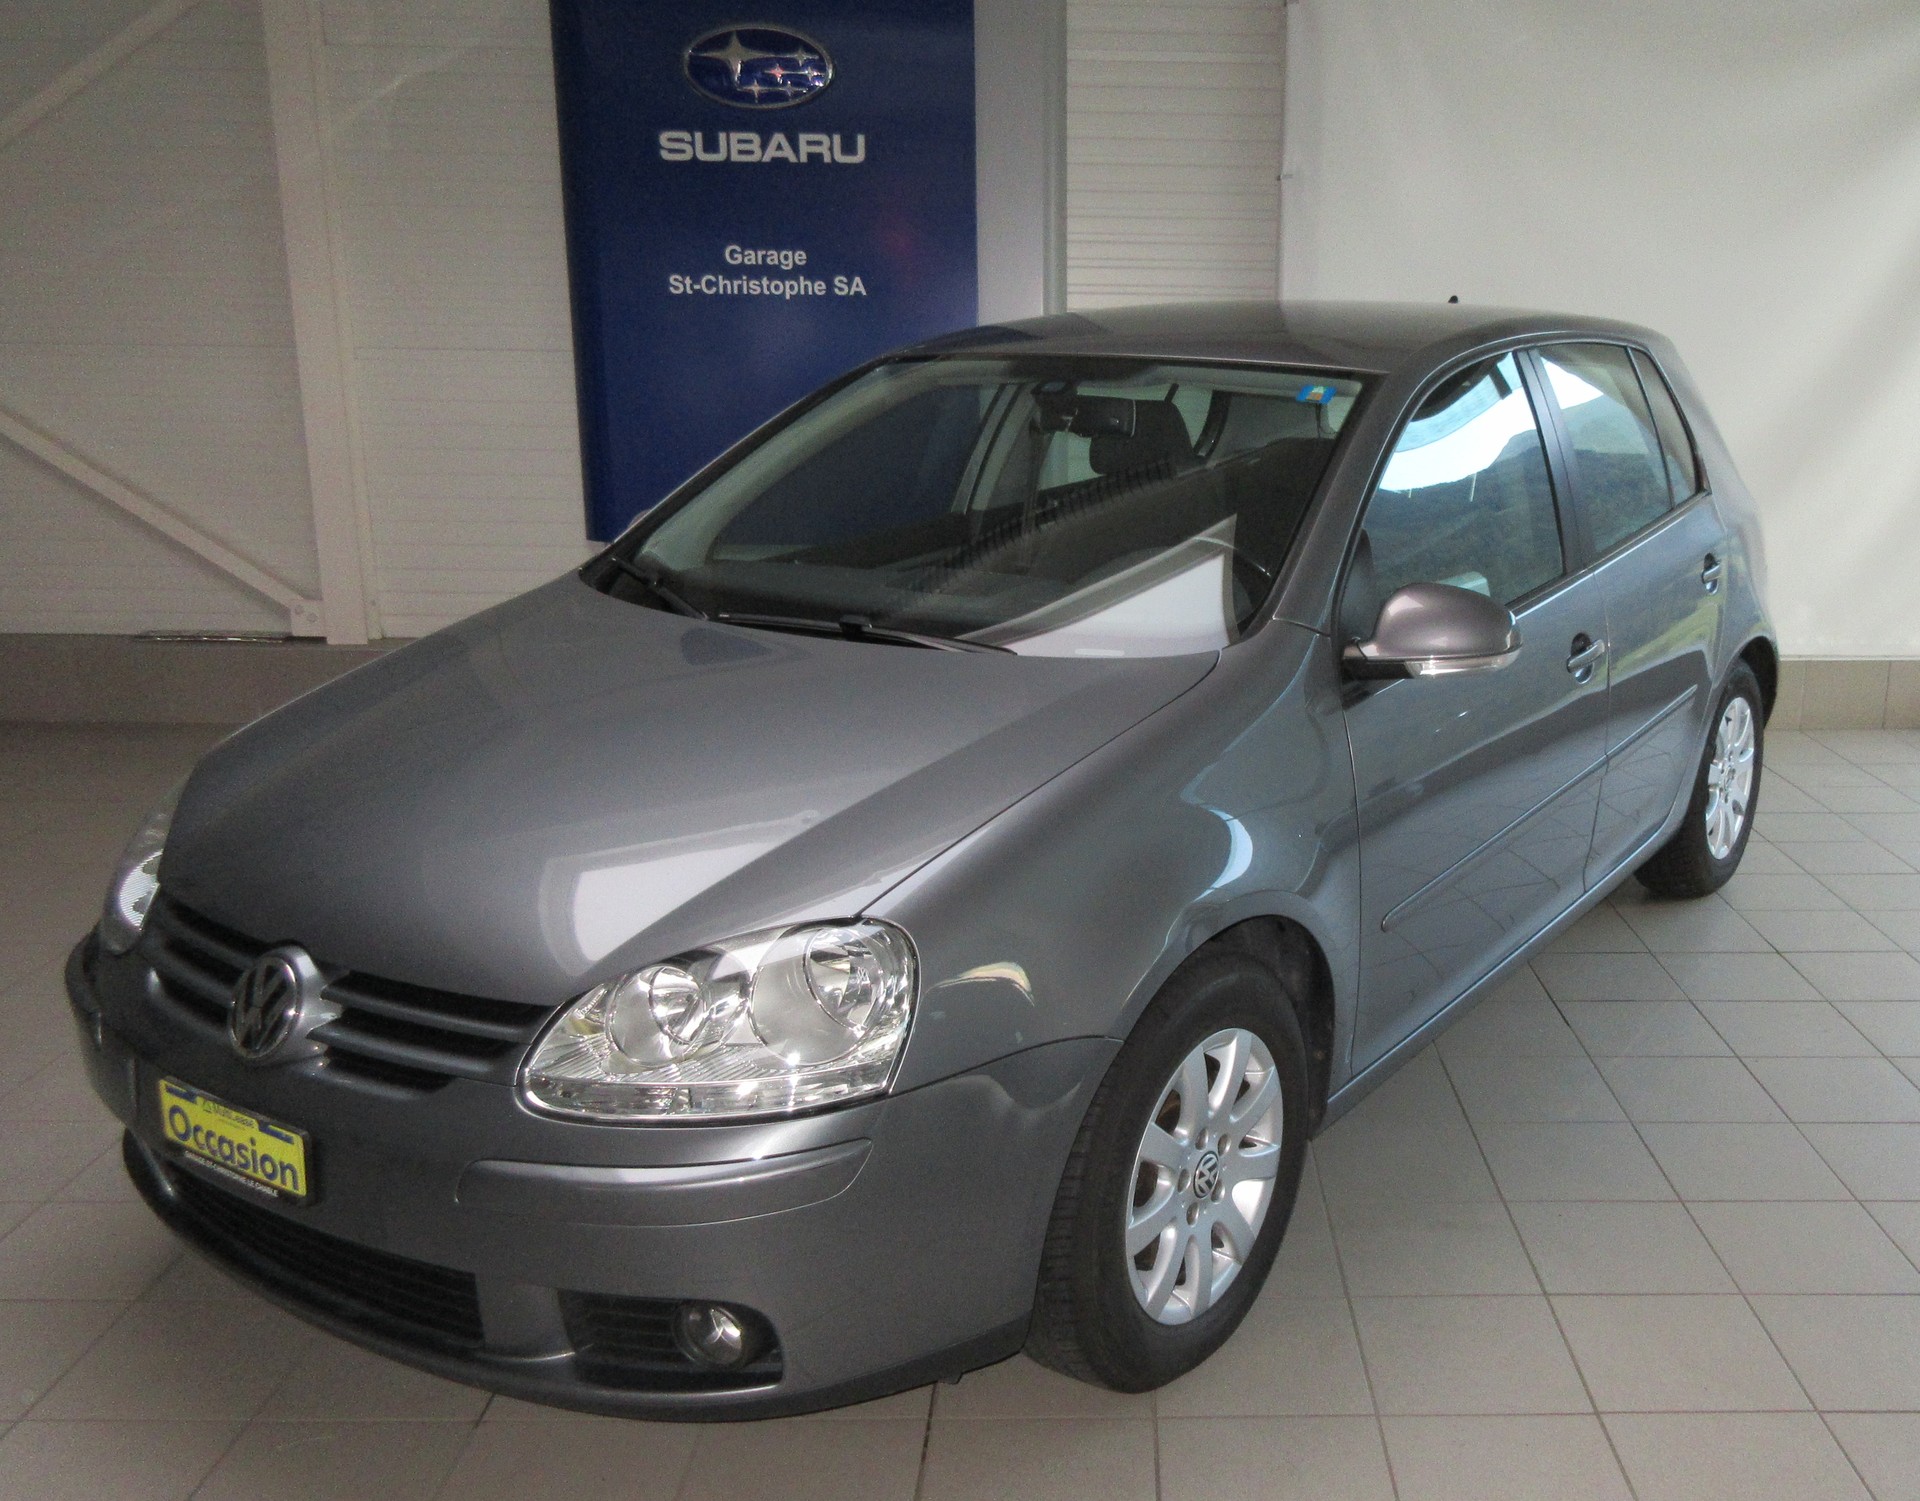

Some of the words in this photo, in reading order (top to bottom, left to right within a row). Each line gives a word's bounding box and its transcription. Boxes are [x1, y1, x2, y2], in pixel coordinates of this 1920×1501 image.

[659, 131, 866, 163] SUBARU
[724, 245, 808, 269] Garage
[668, 275, 827, 300] St-Christophe
[833, 276, 867, 297] SA
[168, 1104, 300, 1191] Occasion
